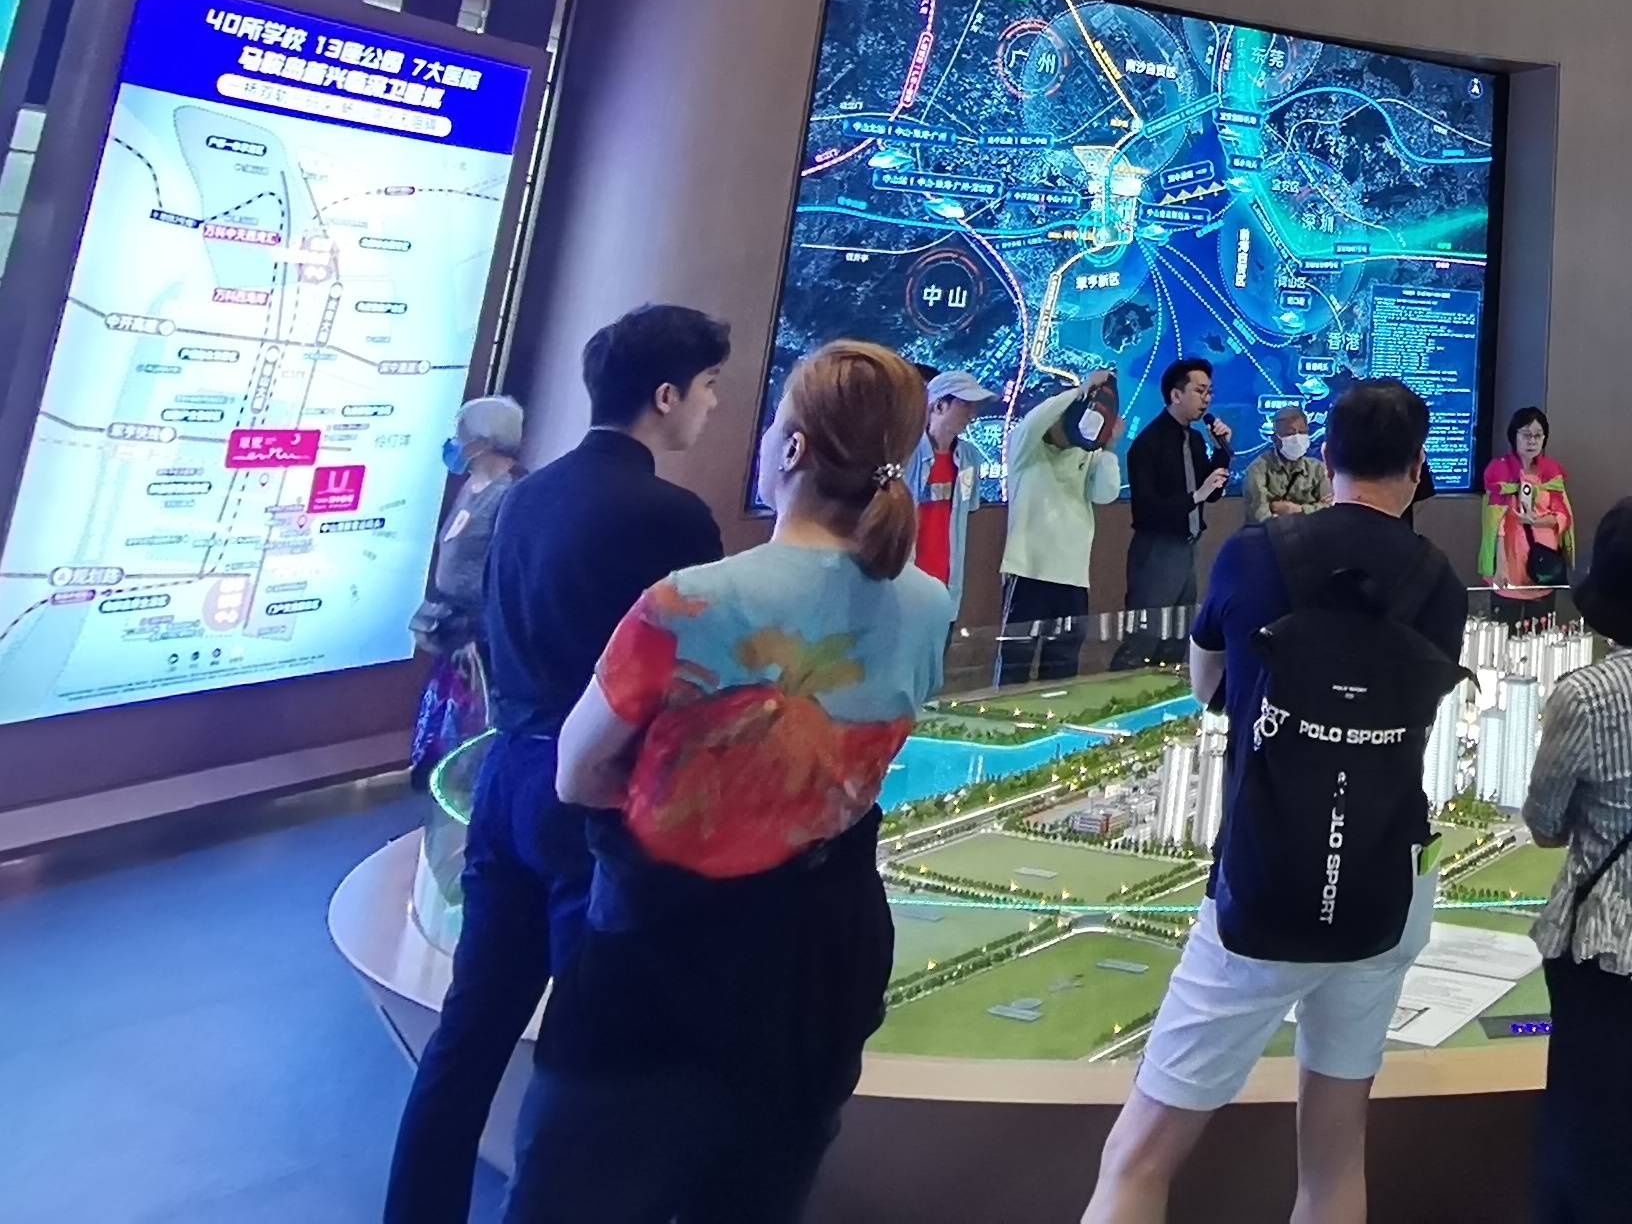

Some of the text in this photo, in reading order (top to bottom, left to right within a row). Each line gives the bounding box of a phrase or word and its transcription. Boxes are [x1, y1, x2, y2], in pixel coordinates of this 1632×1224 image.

[205, 8, 308, 53] 40所学校
[412, 57, 484, 91] 7大医院
[1007, 49, 1056, 75] 广州
[1301, 213, 1336, 233] 深圳
[922, 284, 968, 308] 中山
[1327, 331, 1361, 351] 香港
[1299, 719, 1406, 745] POLO SPORT
[1319, 854, 1341, 925] SPORT
